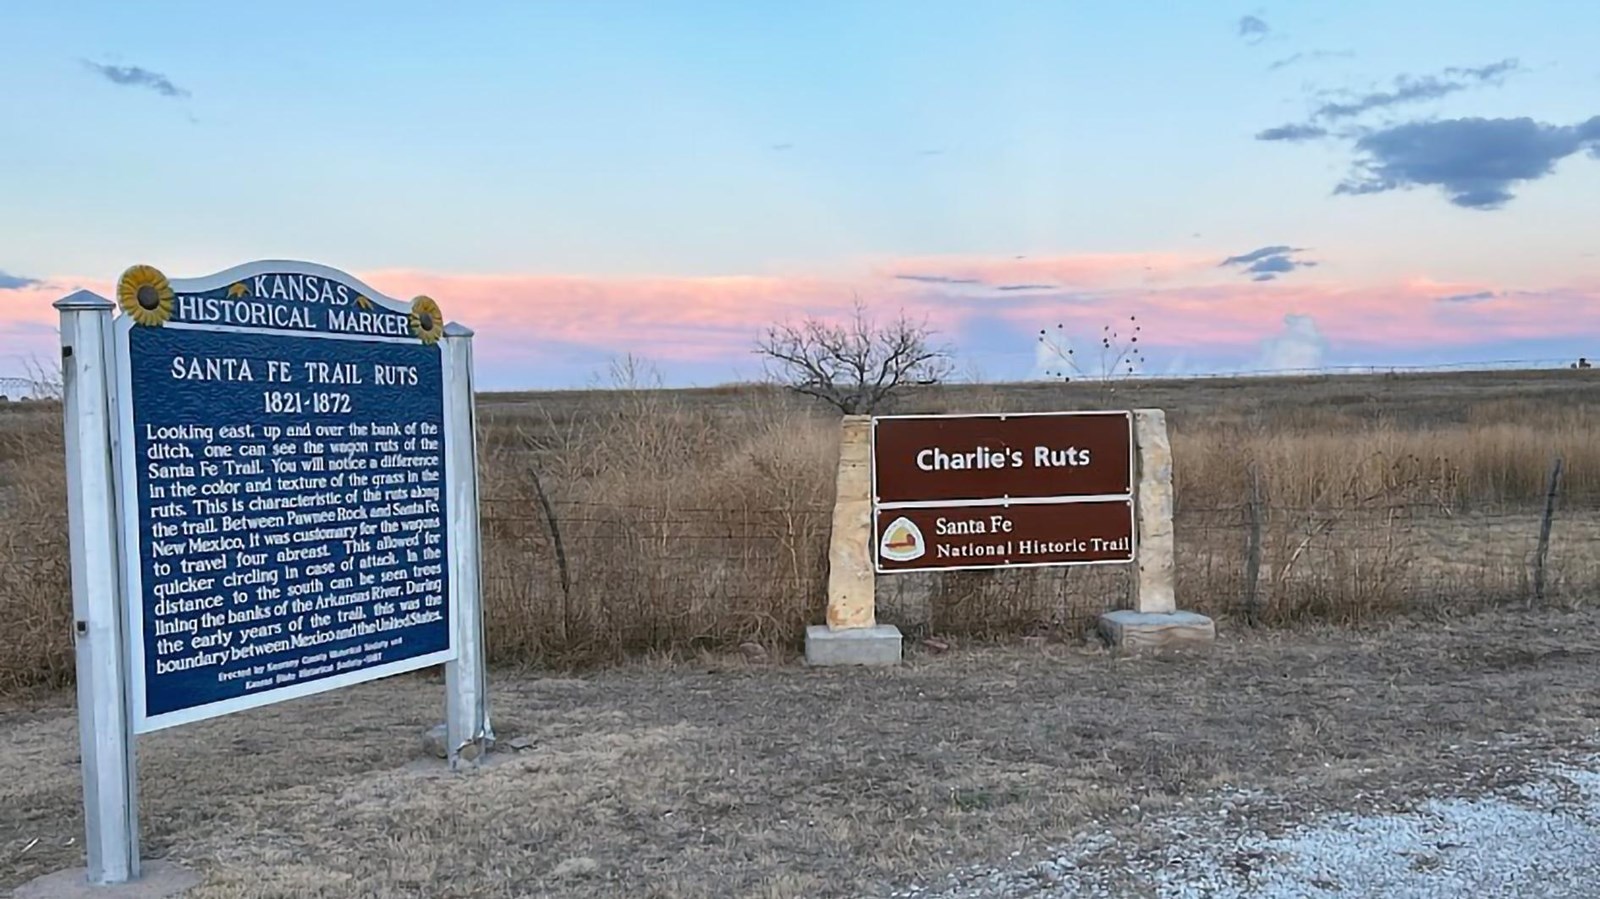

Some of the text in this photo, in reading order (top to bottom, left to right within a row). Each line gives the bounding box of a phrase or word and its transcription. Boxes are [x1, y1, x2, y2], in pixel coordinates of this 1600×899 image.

[254, 273, 348, 306] KANSAS
[178, 296, 409, 335] HISTORICAL MARKER
[171, 356, 418, 386] SANTA FE TRAIL RUTS
[263, 391, 352, 414] 1821-1872
[146, 424, 213, 443] Looking
[263, 426, 281, 441] up
[286, 423, 311, 437] and
[316, 425, 344, 436] over
[349, 422, 368, 436] the
[371, 422, 401, 436] bank
[404, 422, 417, 435] of
[421, 422, 438, 435] the
[204, 445, 232, 457] one
[239, 445, 265, 455] can
[272, 442, 296, 455] see
[304, 441, 324, 454] the
[330, 442, 368, 459] wagon
[375, 440, 398, 451] ruts
[404, 437, 416, 451] of
[421, 438, 438, 450] the
[149, 454, 438, 479] Santa Fe Trail. You will notice a difference
[916, 446, 1090, 471] Charlie's Ruts
[150, 470, 439, 498] in the color and texture of the grass in the
[151, 486, 439, 518] ruts. This is characteristic of the ruts along
[152, 522, 178, 538] the
[222, 516, 284, 531] Between
[287, 511, 335, 526] Pawnee
[337, 505, 368, 521] Rock
[370, 504, 391, 518] and
[393, 503, 424, 516] Santa
[936, 516, 1012, 535] Santa Fe
[152, 541, 187, 558] New
[189, 536, 245, 554] Mexico,
[264, 532, 290, 546] was
[293, 525, 357, 542] customary
[360, 522, 377, 536] for
[381, 520, 399, 533] the
[401, 517, 440, 532] wagons
[153, 562, 171, 576] to
[180, 554, 226, 573] travel
[236, 551, 268, 567] four
[343, 539, 371, 554] This
[377, 532, 419, 549] allowed
[425, 531, 441, 544] for
[937, 536, 1129, 559] National Historic Trail
[154, 577, 214, 598] quicker
[223, 569, 278, 587] circling
[285, 566, 299, 579] in
[306, 563, 335, 576] case
[341, 557, 354, 570] of
[424, 548, 441, 559] the
[155, 563, 441, 616] distance to the south can be seen trees
[155, 579, 442, 636] lining the banks of the Arkansas River. During
[157, 639, 184, 654] the
[191, 630, 232, 648] early
[240, 623, 281, 644] years
[288, 616, 303, 631] of
[311, 614, 331, 628] the
[374, 603, 394, 616] this
[400, 599, 420, 611] was
[425, 595, 442, 607] the
[156, 651, 230, 674] boundary
[231, 640, 289, 660] between
[290, 631, 335, 649] Mexico
[336, 625, 356, 640] and
[358, 622, 376, 635] the
[376, 615, 410, 631] United
